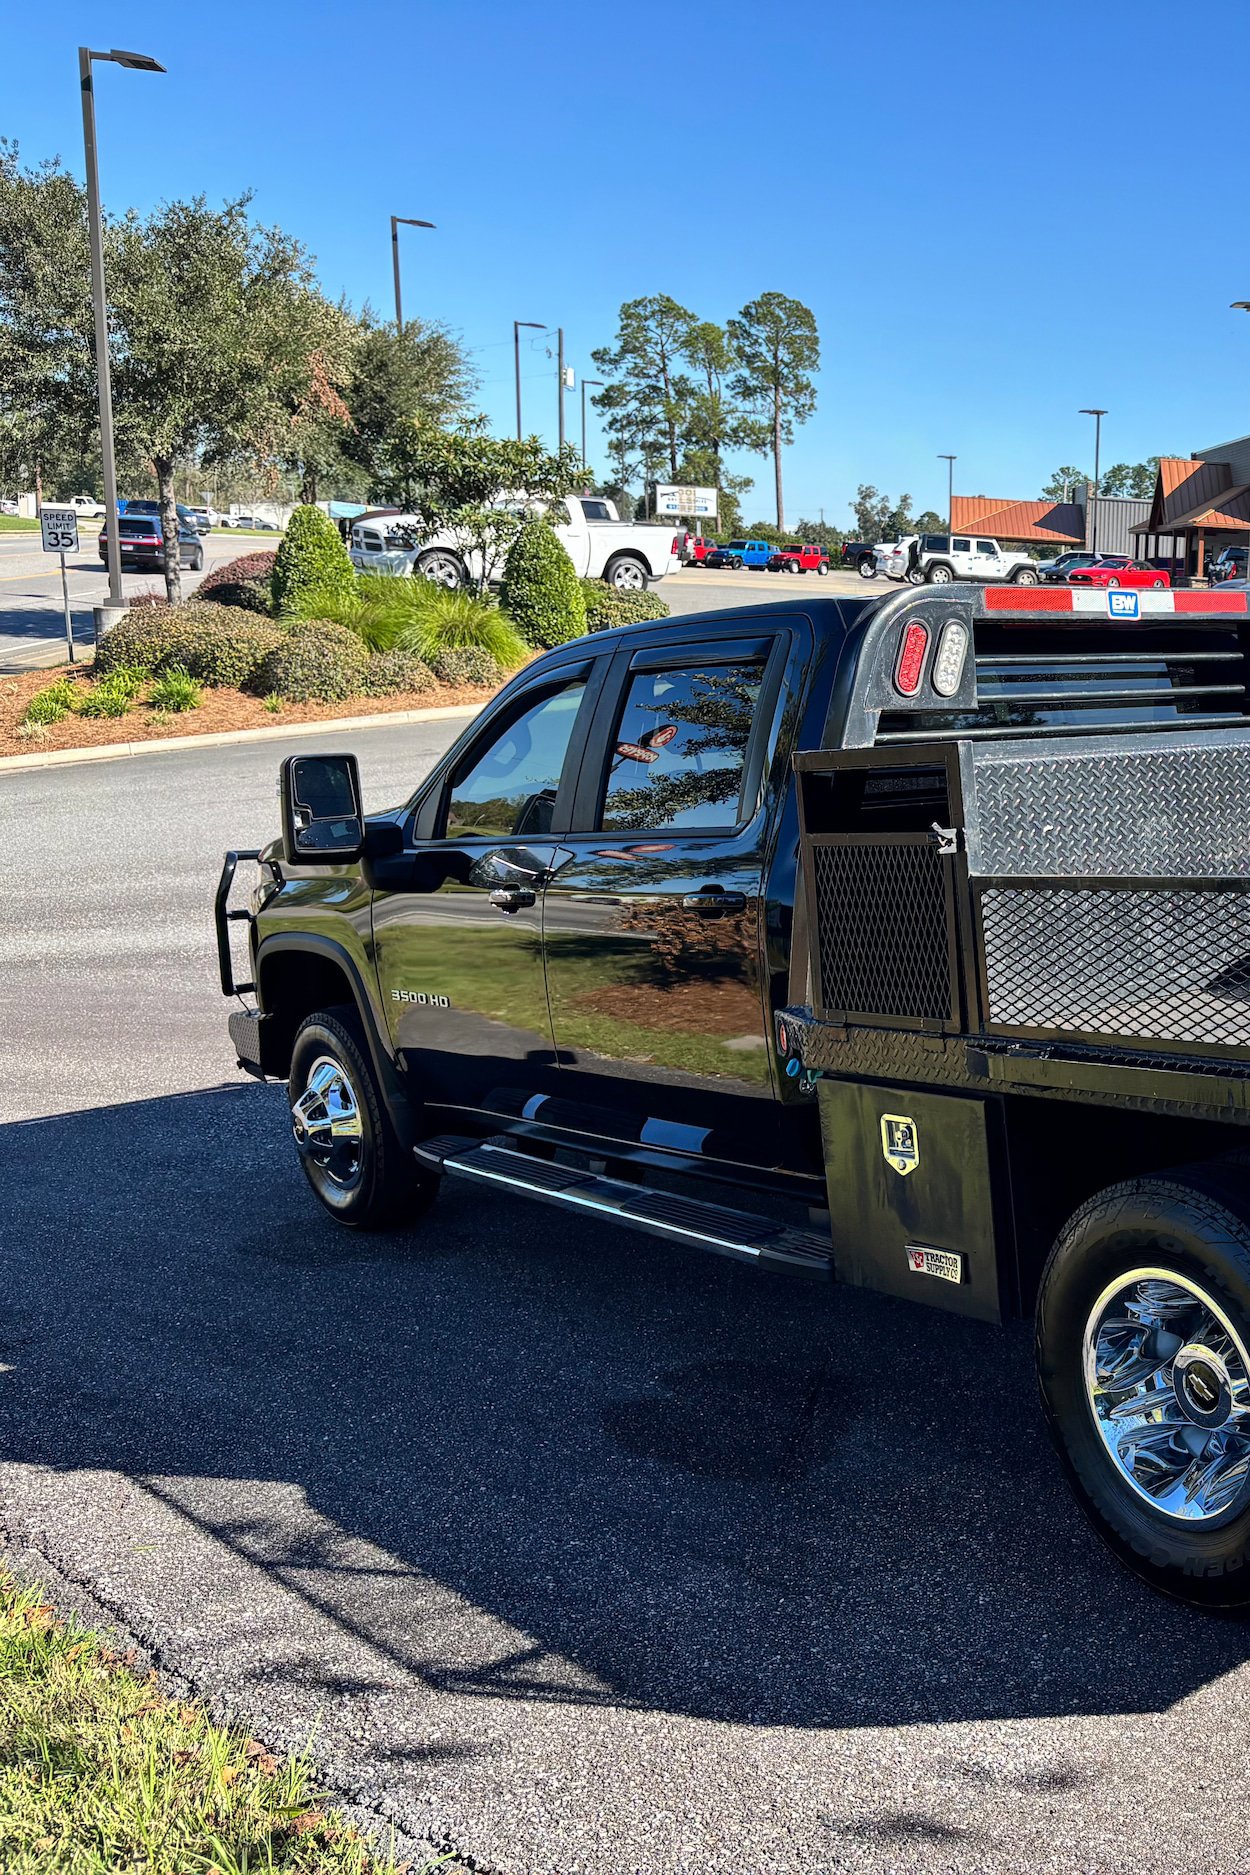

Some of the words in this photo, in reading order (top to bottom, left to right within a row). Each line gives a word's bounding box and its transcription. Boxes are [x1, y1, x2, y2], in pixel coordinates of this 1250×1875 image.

[43, 513, 74, 521] SPEED
[47, 522, 71, 530] LIMIT
[48, 531, 74, 547] 35
[391, 989, 427, 1005] 3500
[430, 994, 449, 1008] HD
[924, 1252, 958, 1268] TRACTOR
[926, 1262, 950, 1277] SUPPLY
